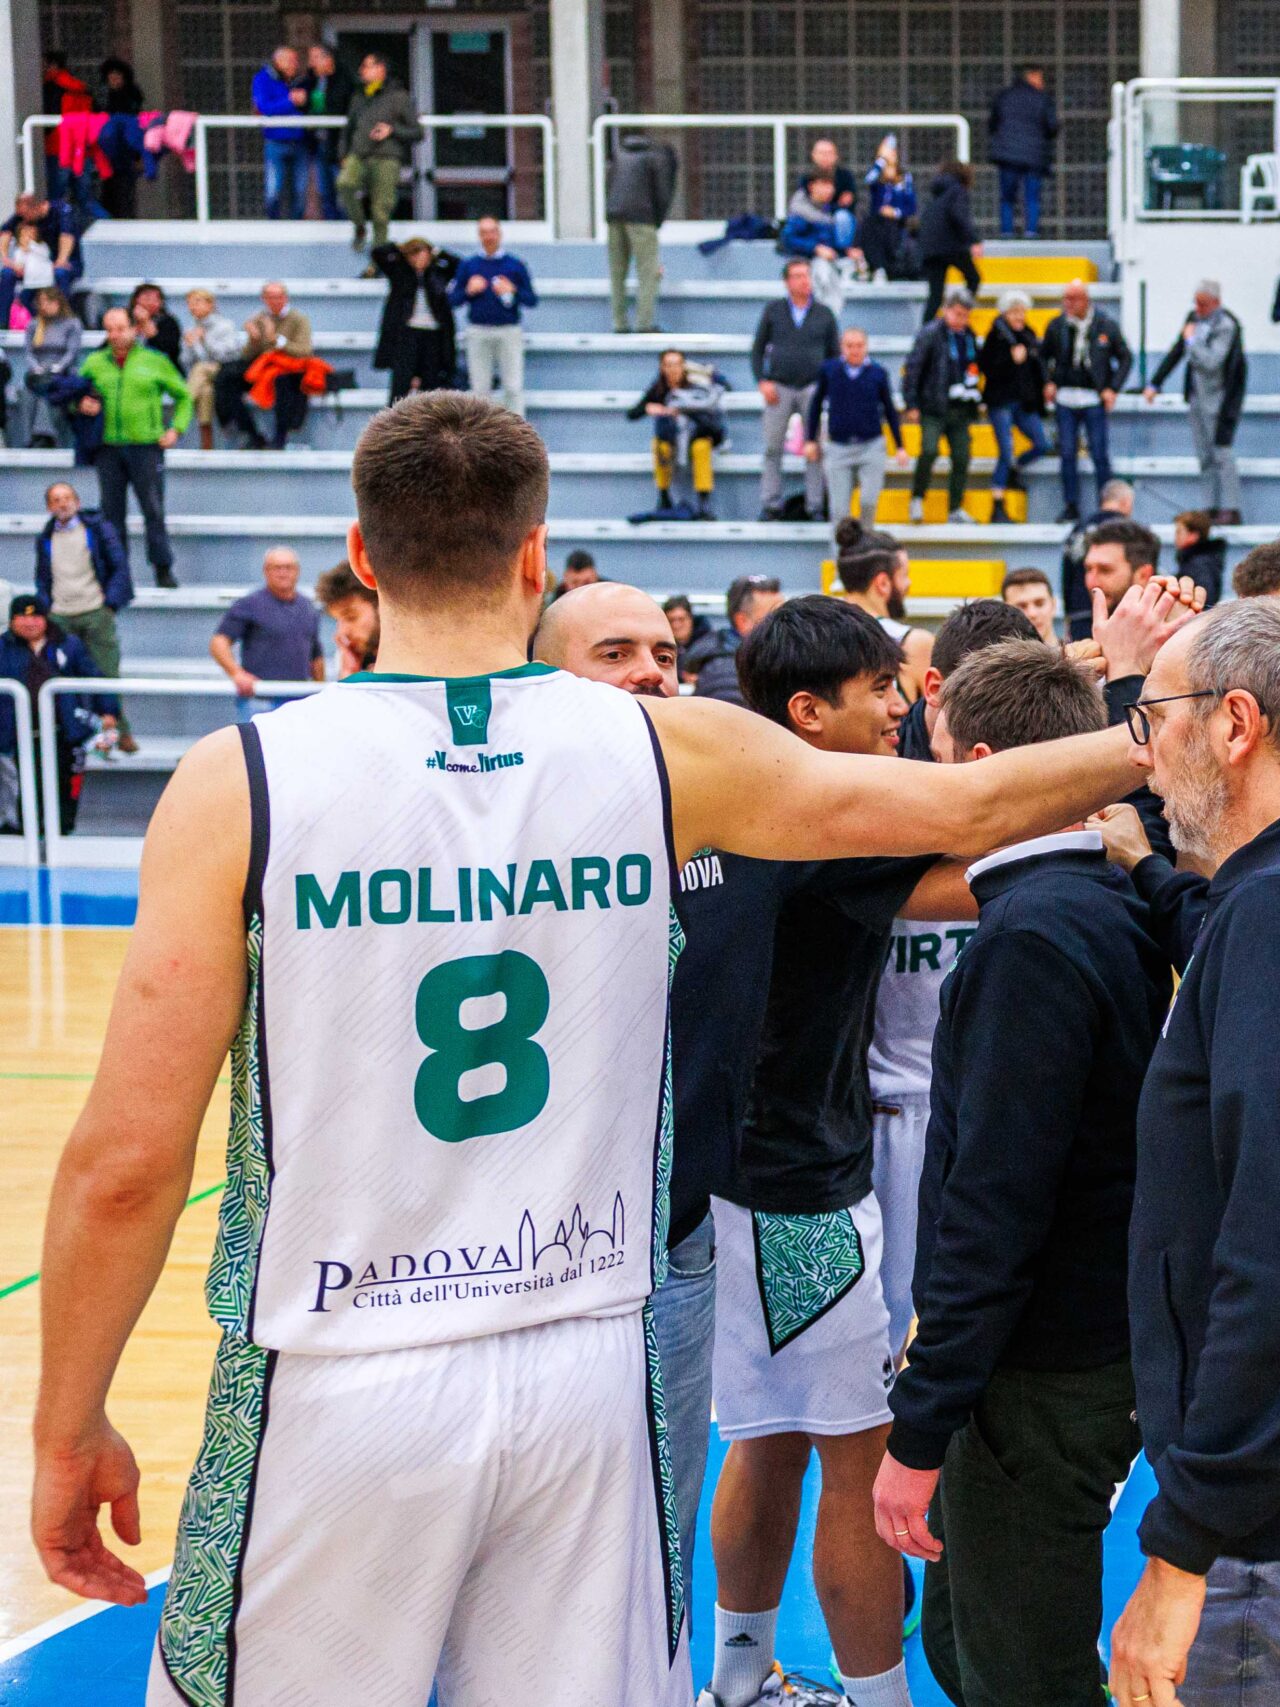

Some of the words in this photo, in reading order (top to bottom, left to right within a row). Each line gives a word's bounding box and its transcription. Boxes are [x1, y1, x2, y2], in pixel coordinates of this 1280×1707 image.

[295, 853, 652, 930] MOLINARO
[413, 949, 551, 1144] 8
[307, 1244, 513, 1312] PADOVA
[353, 1286, 402, 1309] Città
[410, 1272, 554, 1303] dell'Università
[560, 1261, 583, 1283] dal
[590, 1250, 625, 1274] 1222
